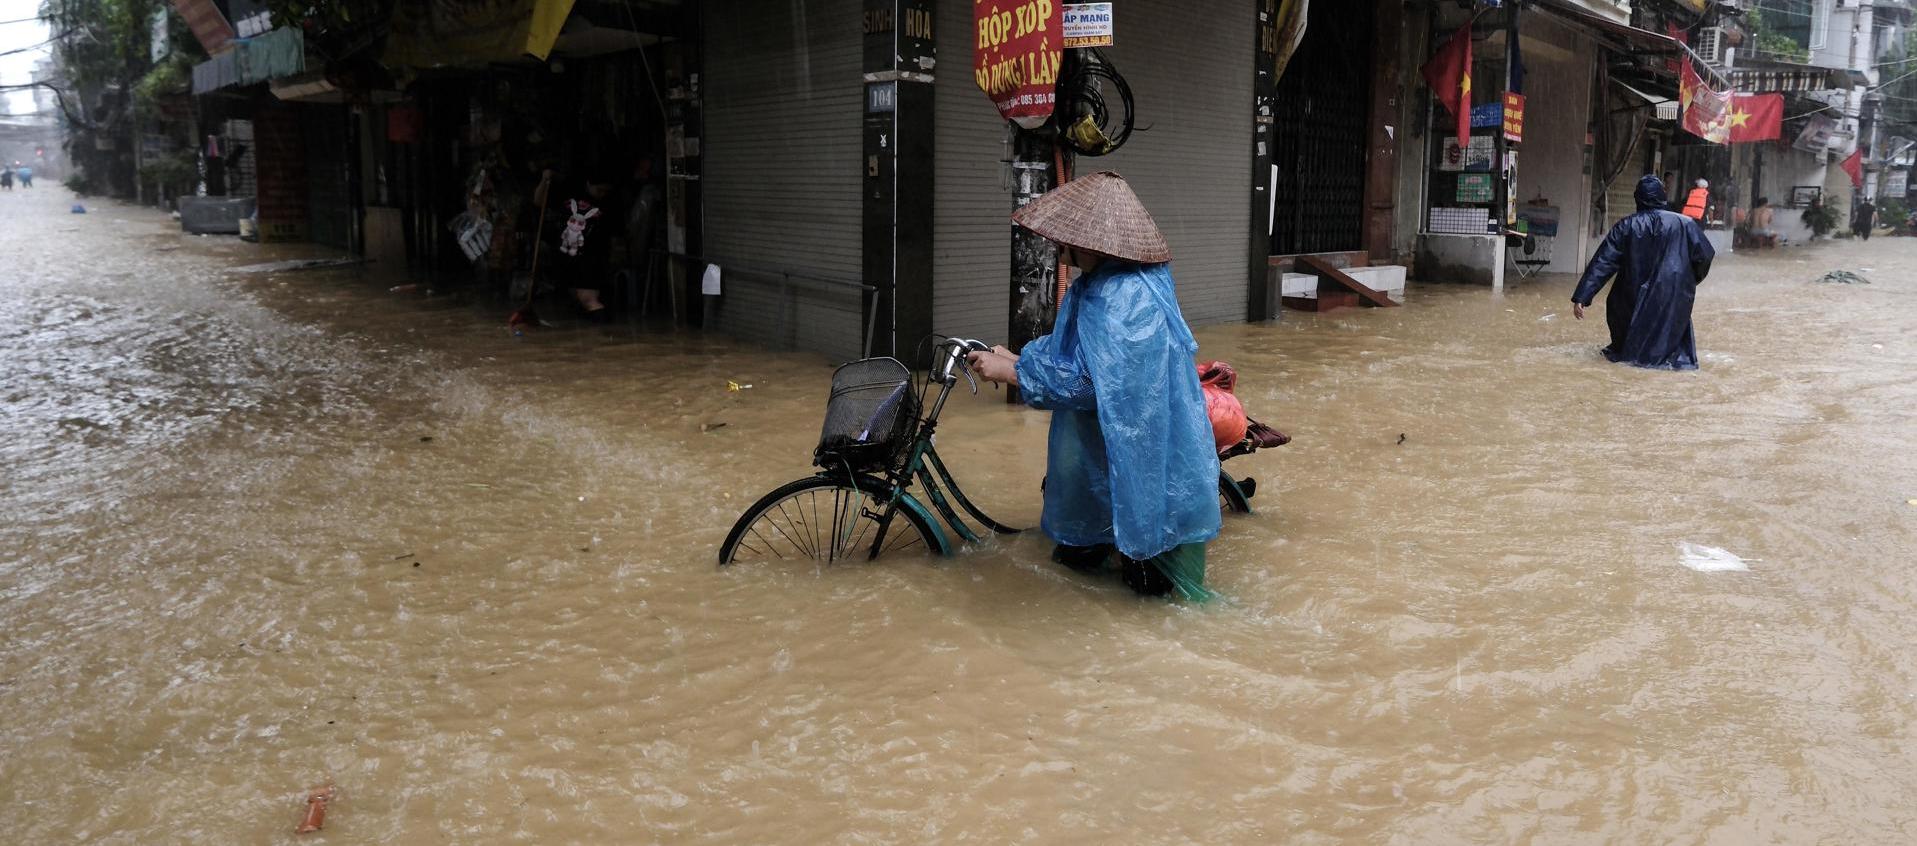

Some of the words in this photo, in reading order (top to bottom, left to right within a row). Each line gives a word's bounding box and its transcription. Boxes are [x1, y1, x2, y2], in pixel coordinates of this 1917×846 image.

[864, 8, 892, 34] SINH
[979, 5, 1012, 52] HỘP
[1080, 13, 1109, 24] MẠNG
[1029, 36, 1061, 85] LẦN
[873, 90, 892, 107] 104
